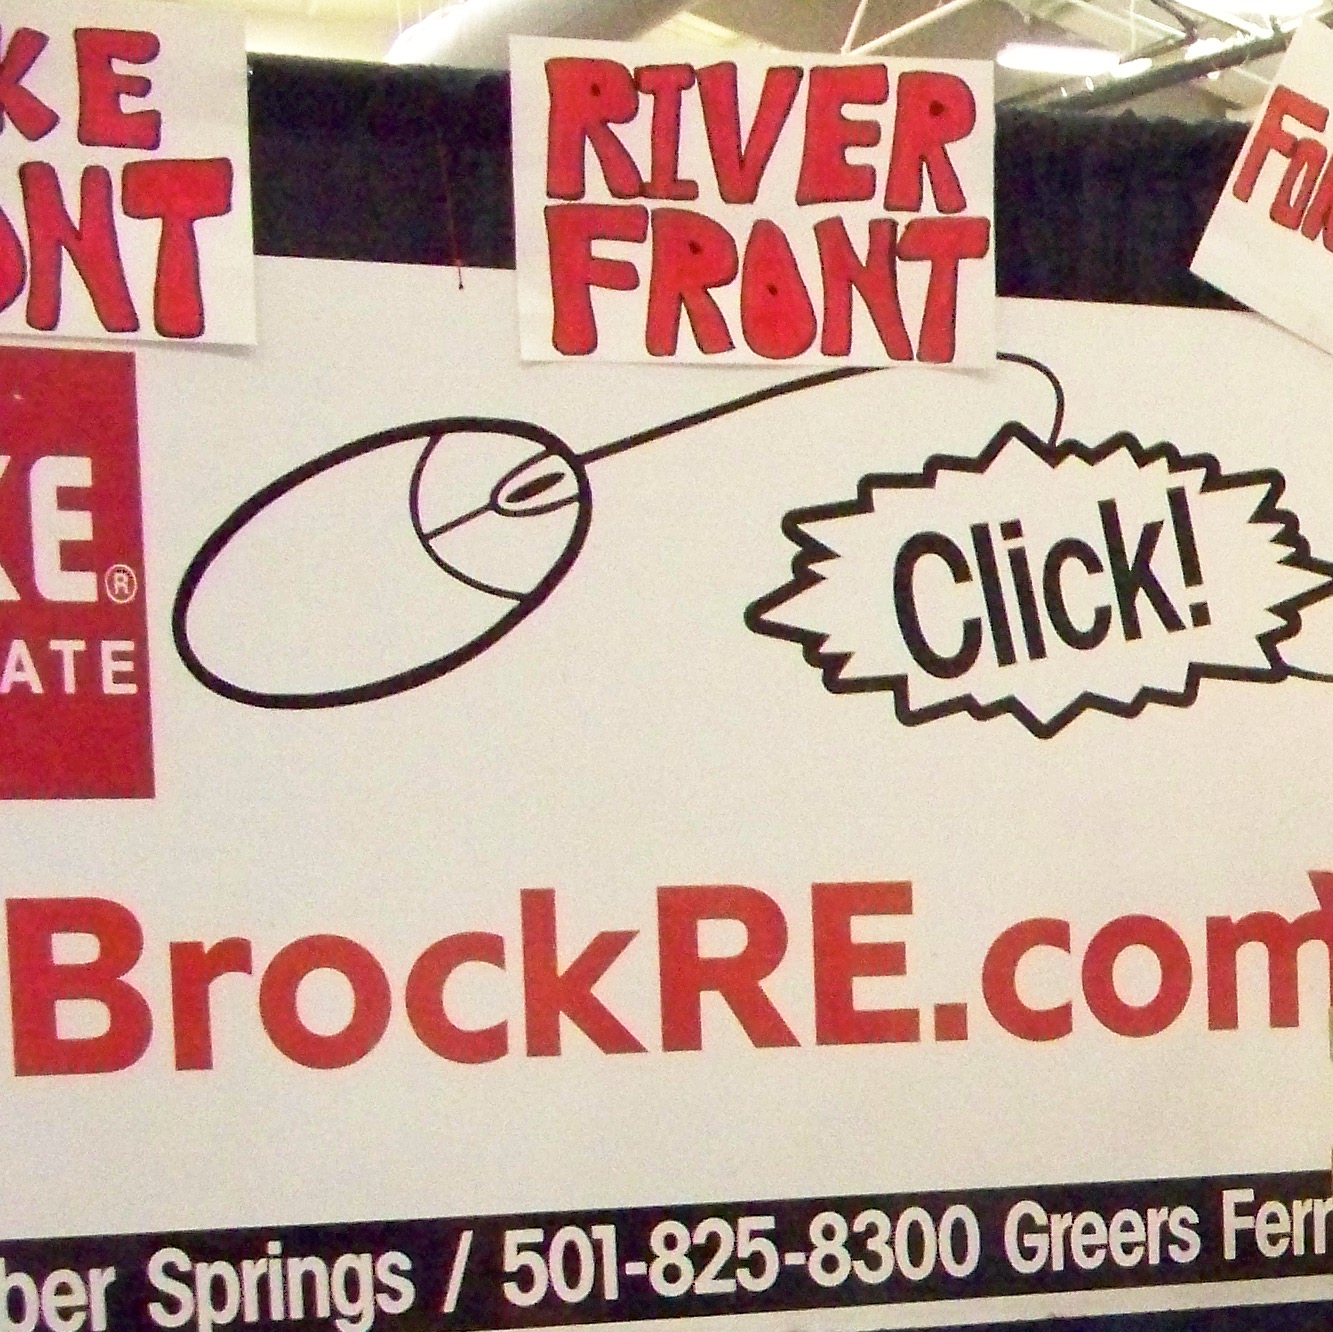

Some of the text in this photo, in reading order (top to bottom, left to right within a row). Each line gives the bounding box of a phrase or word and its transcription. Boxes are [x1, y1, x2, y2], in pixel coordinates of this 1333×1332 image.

[545, 57, 977, 213] RIVER
[543, 204, 990, 363] FRONT
[893, 486, 1211, 680] Click!
[503, 1203, 981, 1307] 501-825-8300
[1004, 1199, 1202, 1275] Greers
